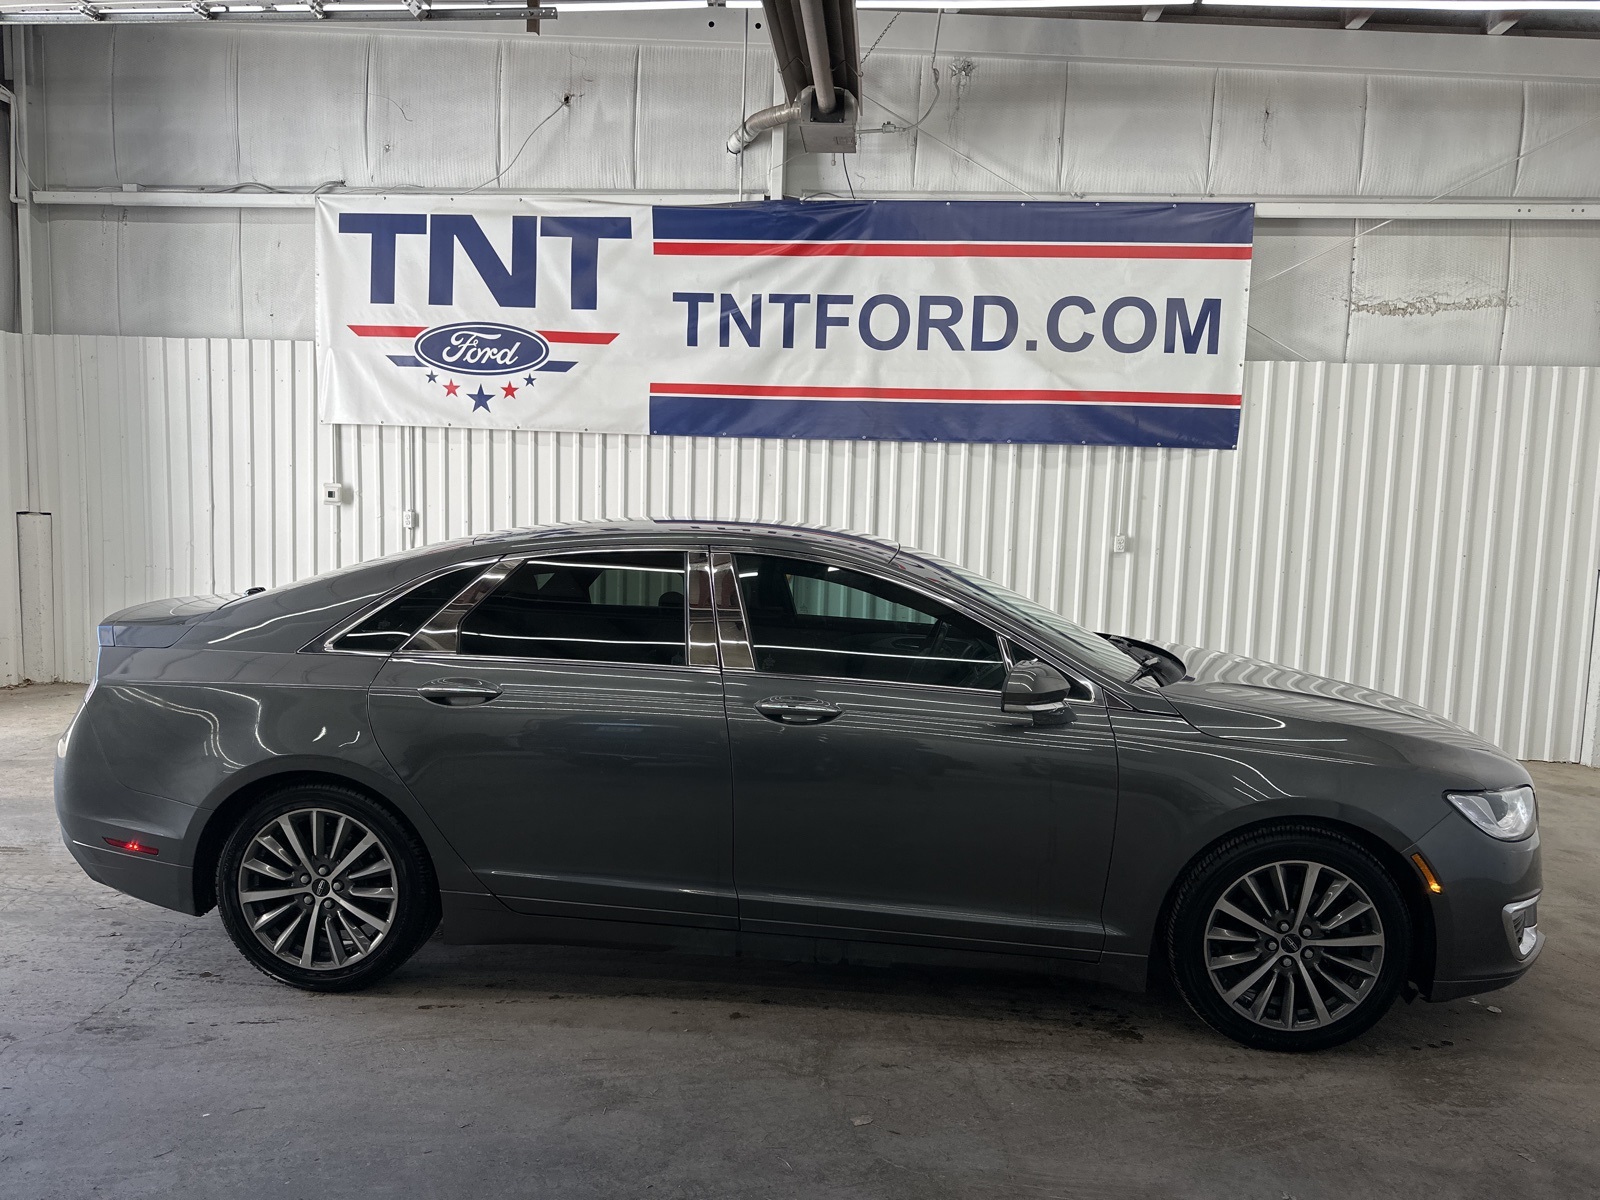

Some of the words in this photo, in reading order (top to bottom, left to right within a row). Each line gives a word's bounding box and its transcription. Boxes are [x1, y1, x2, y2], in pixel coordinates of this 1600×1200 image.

[339, 213, 632, 310] TNT
[442, 331, 521, 365] Ford
[672, 292, 1222, 355] TNTFORD.COM
